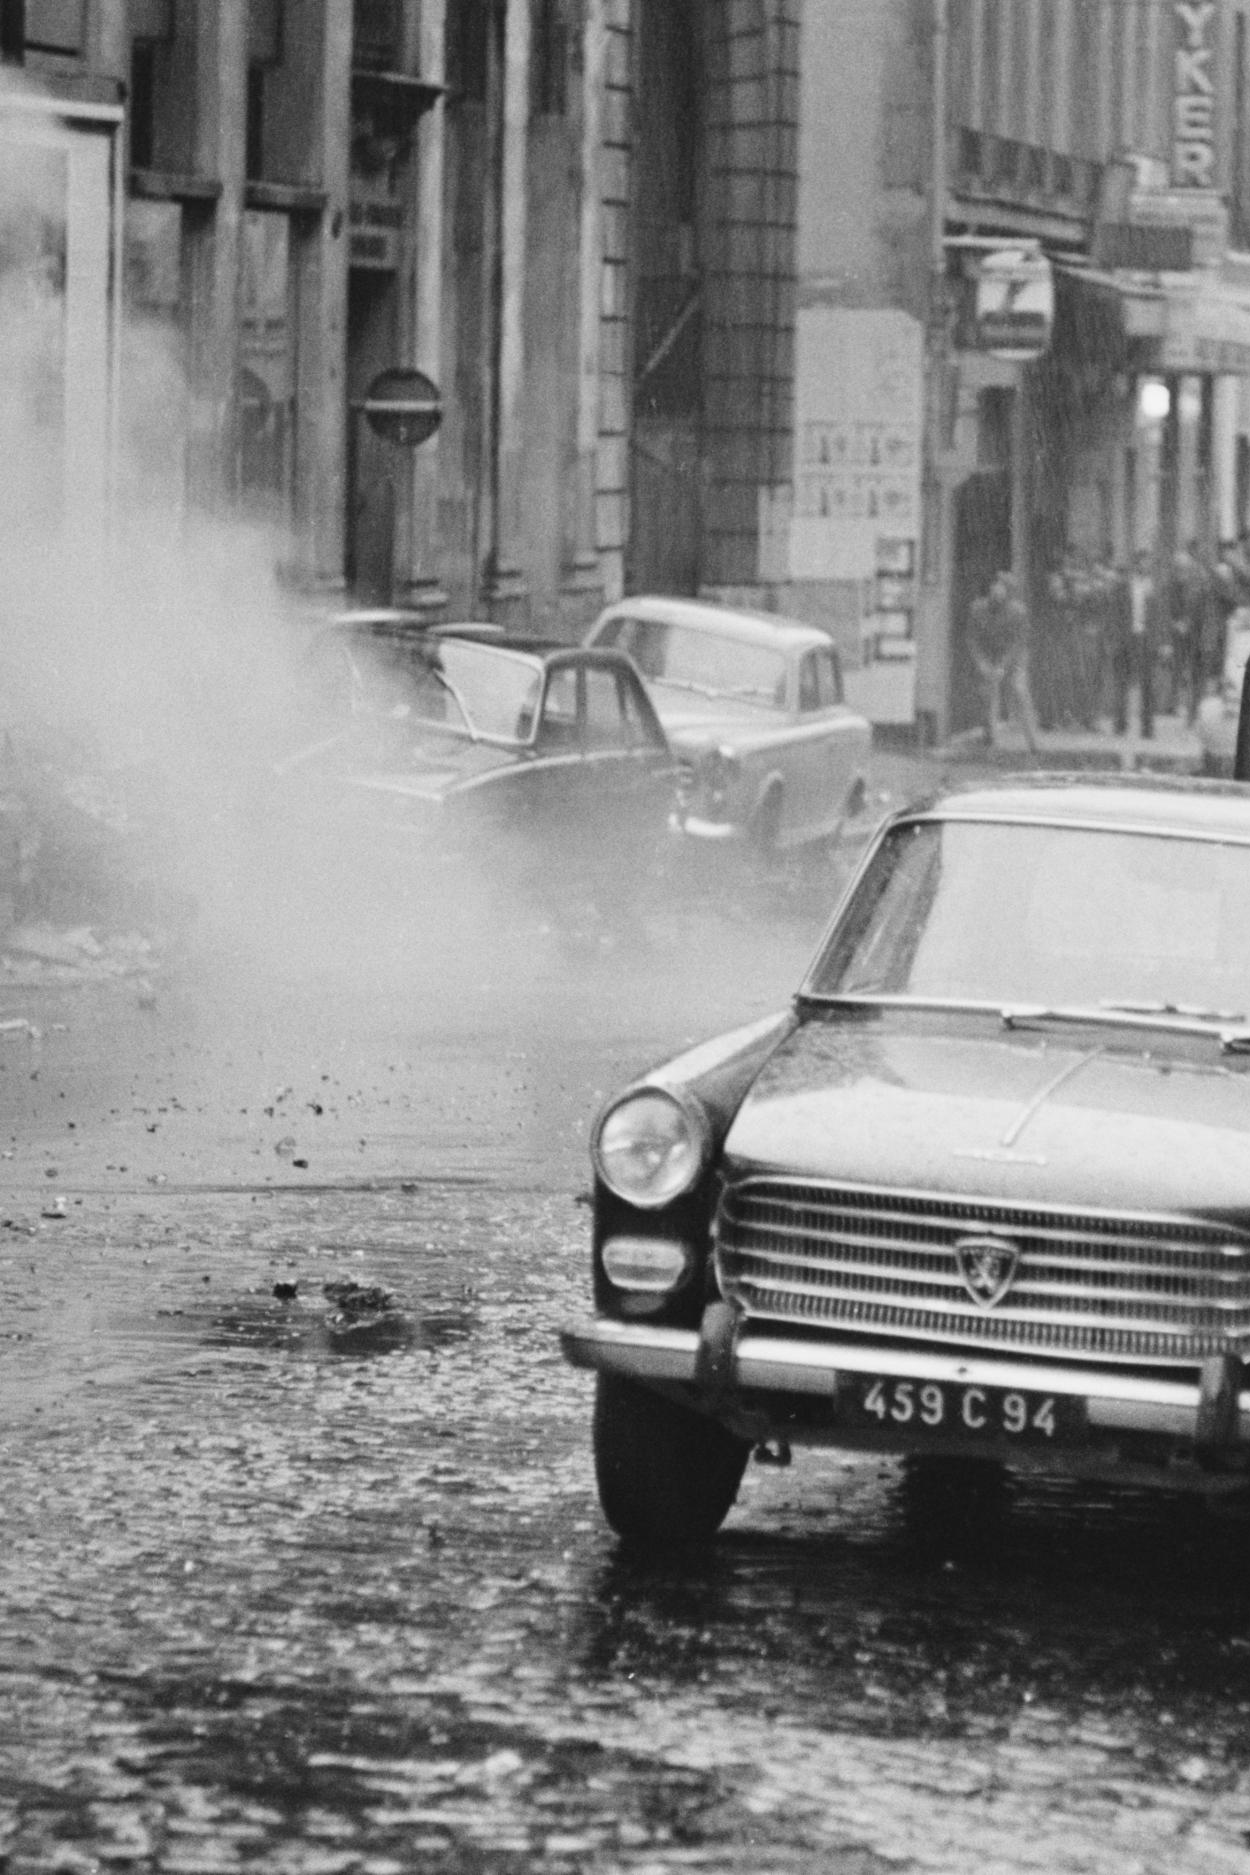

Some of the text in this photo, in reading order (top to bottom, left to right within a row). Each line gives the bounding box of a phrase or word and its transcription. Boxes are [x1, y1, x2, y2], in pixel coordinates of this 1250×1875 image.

[863, 1382, 1056, 1437] 459 C 94
